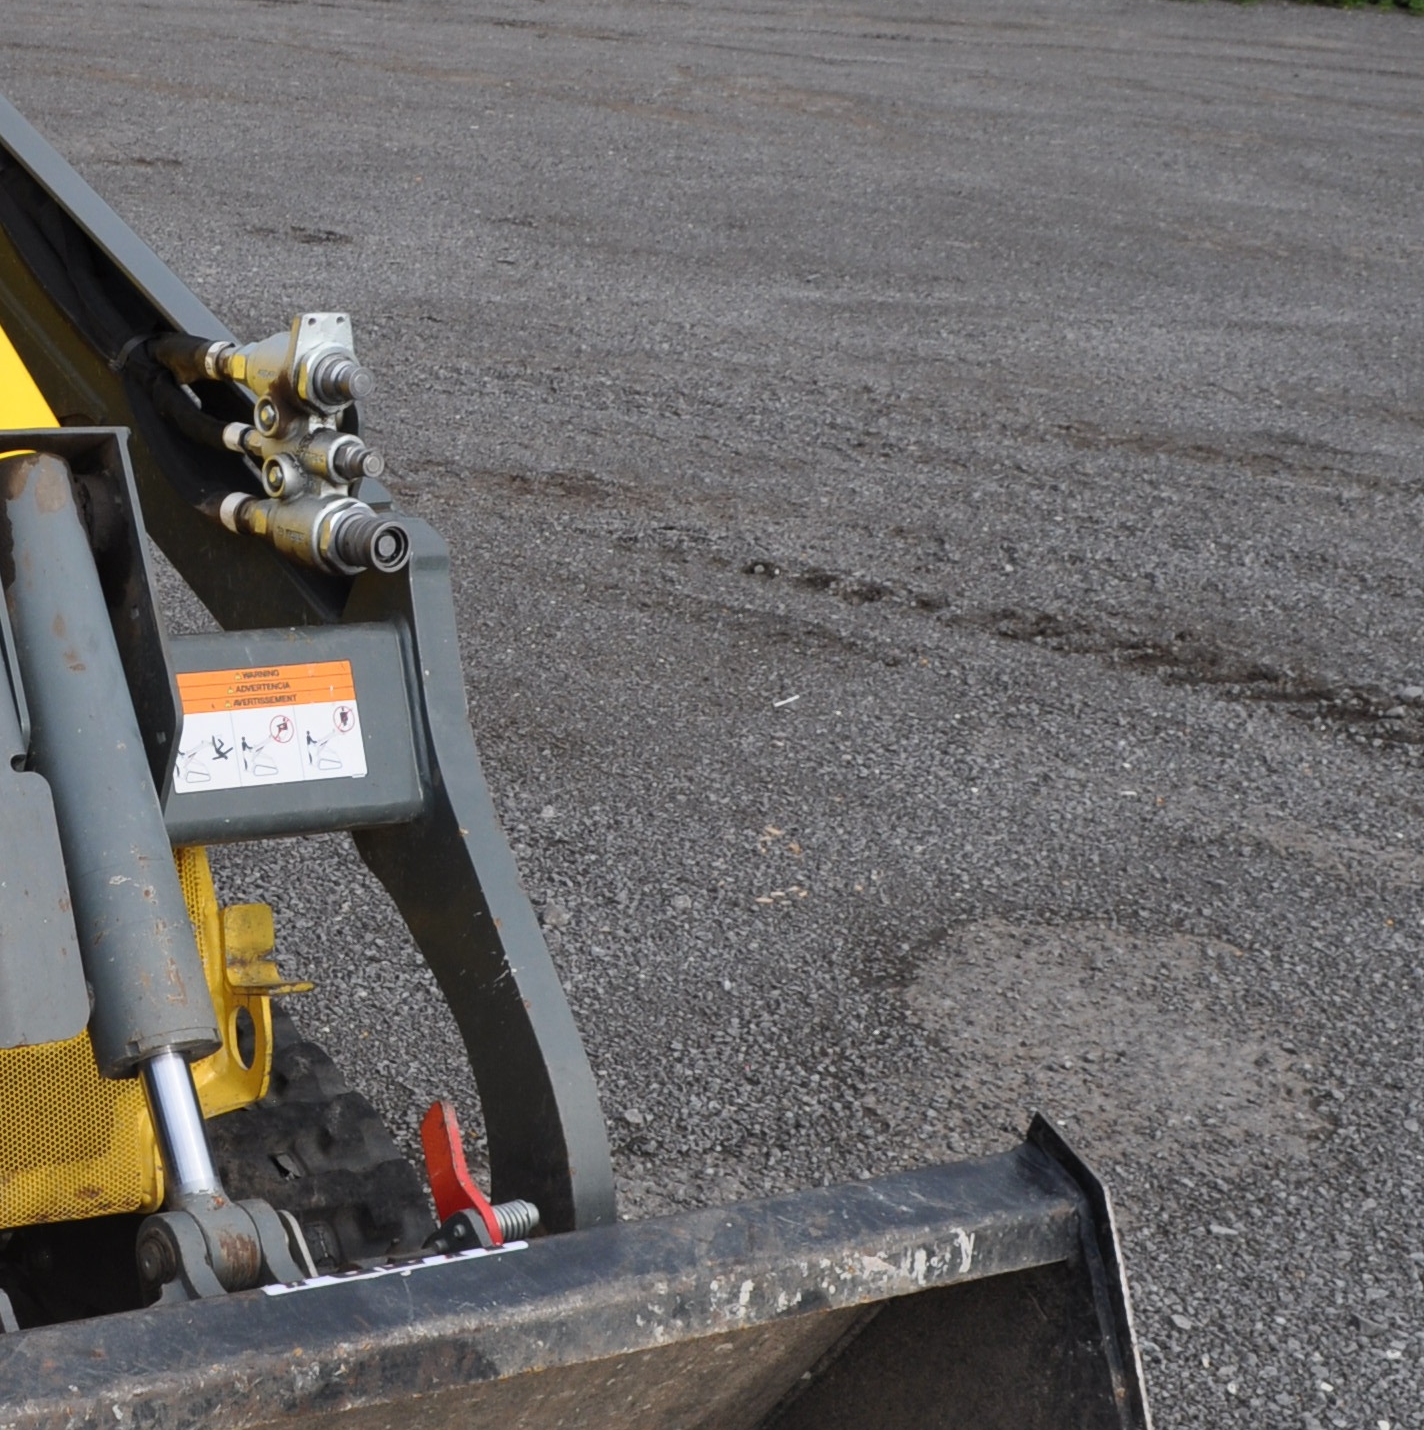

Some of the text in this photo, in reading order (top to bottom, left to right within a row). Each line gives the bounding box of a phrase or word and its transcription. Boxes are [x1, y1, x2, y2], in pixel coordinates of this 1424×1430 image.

[242, 669, 280, 680] WARNING
[235, 681, 291, 693] ADVERTENCIA
[232, 694, 297, 707] AVERTISSEMENT
